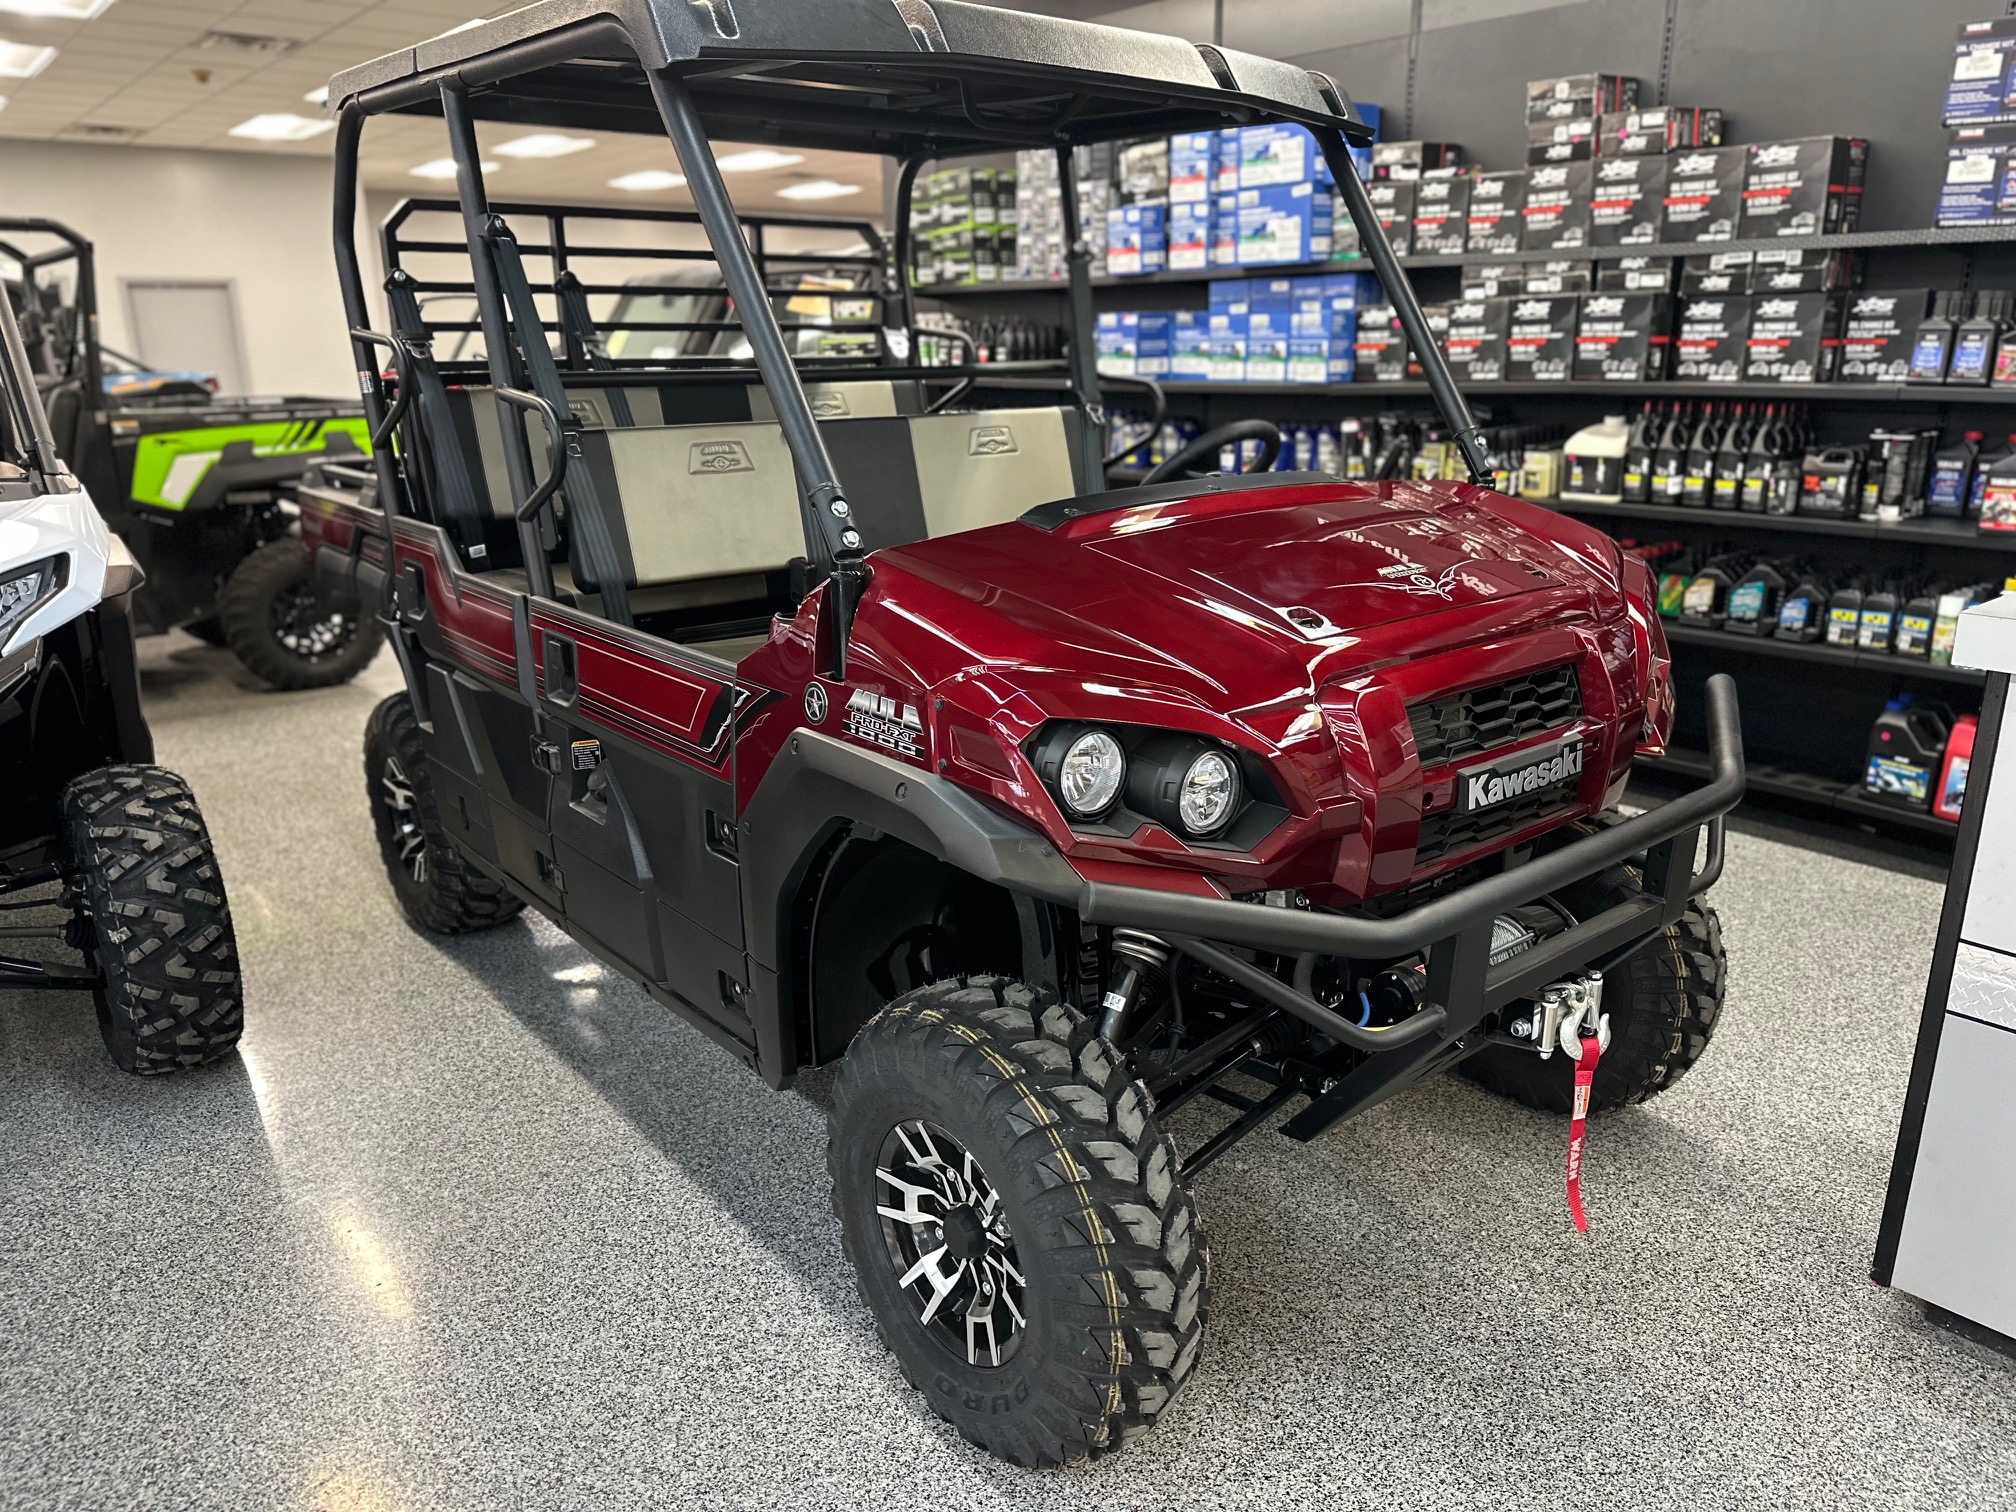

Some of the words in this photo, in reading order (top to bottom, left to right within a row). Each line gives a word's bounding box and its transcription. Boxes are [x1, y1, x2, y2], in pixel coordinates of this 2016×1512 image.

[1752, 144, 1800, 166] XPS
[1756, 298, 1799, 315] XPS
[1851, 296, 1898, 313] XPS
[844, 688, 924, 736] MULE
[849, 723, 916, 756] 1000
[1468, 742, 1583, 811] Kawasaki
[1568, 1136, 1582, 1181] WARN
[933, 1371, 1030, 1416] DURO
